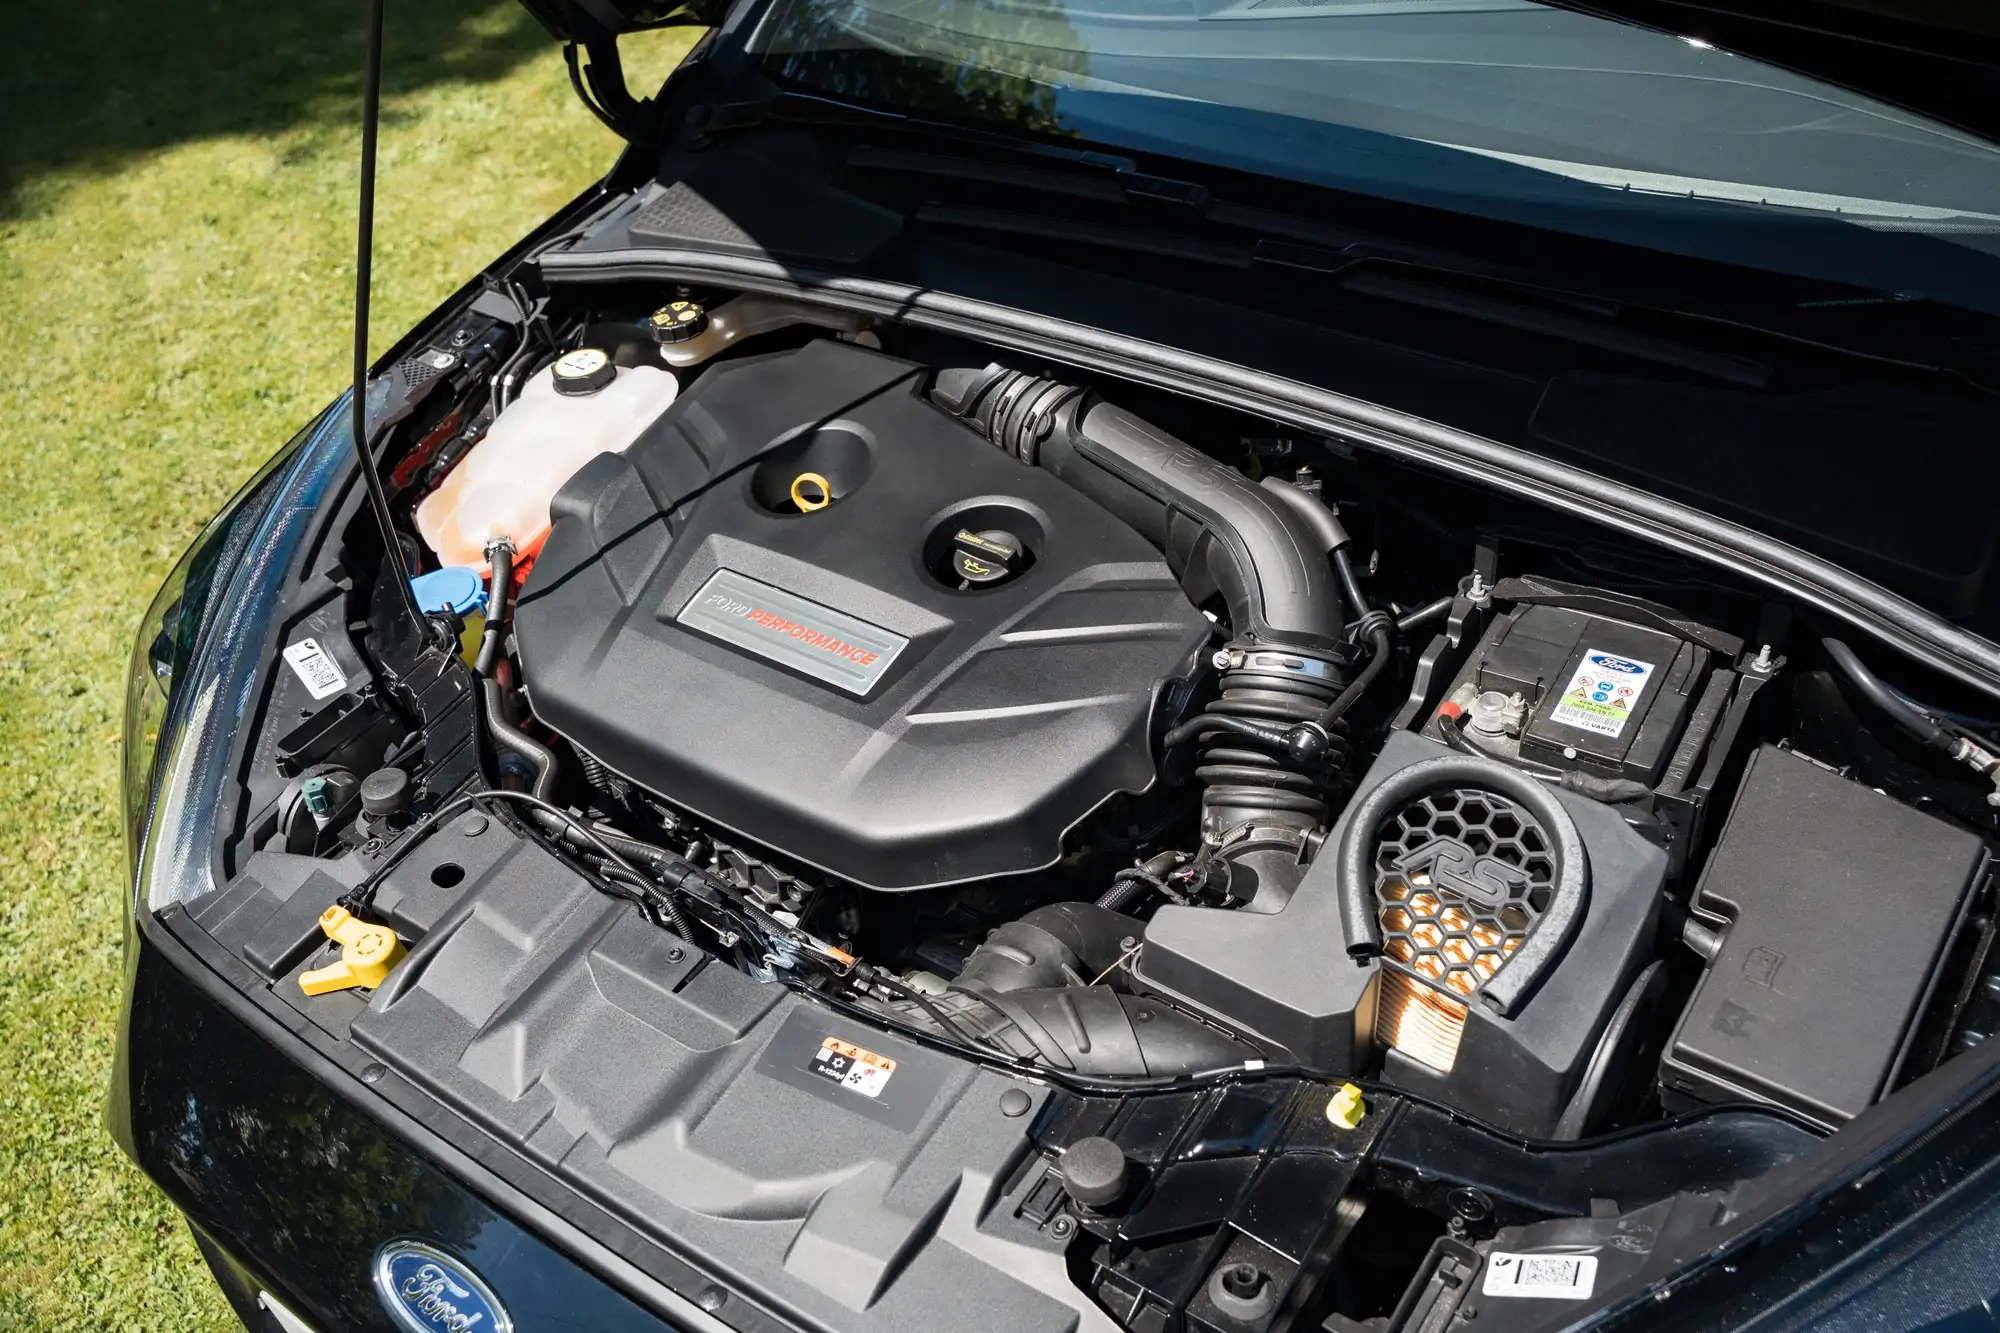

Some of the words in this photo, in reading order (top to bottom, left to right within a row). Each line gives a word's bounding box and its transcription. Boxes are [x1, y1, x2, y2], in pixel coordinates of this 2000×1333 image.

[703, 593, 751, 617] FORD
[746, 608, 879, 667] PERFORMANCE
[1599, 657, 1636, 673] Ford
[1591, 723, 1615, 733] VARTA
[1392, 835, 1533, 906] RS
[818, 1065, 845, 1080] R-1234yf
[402, 1263, 483, 1333] Ford
